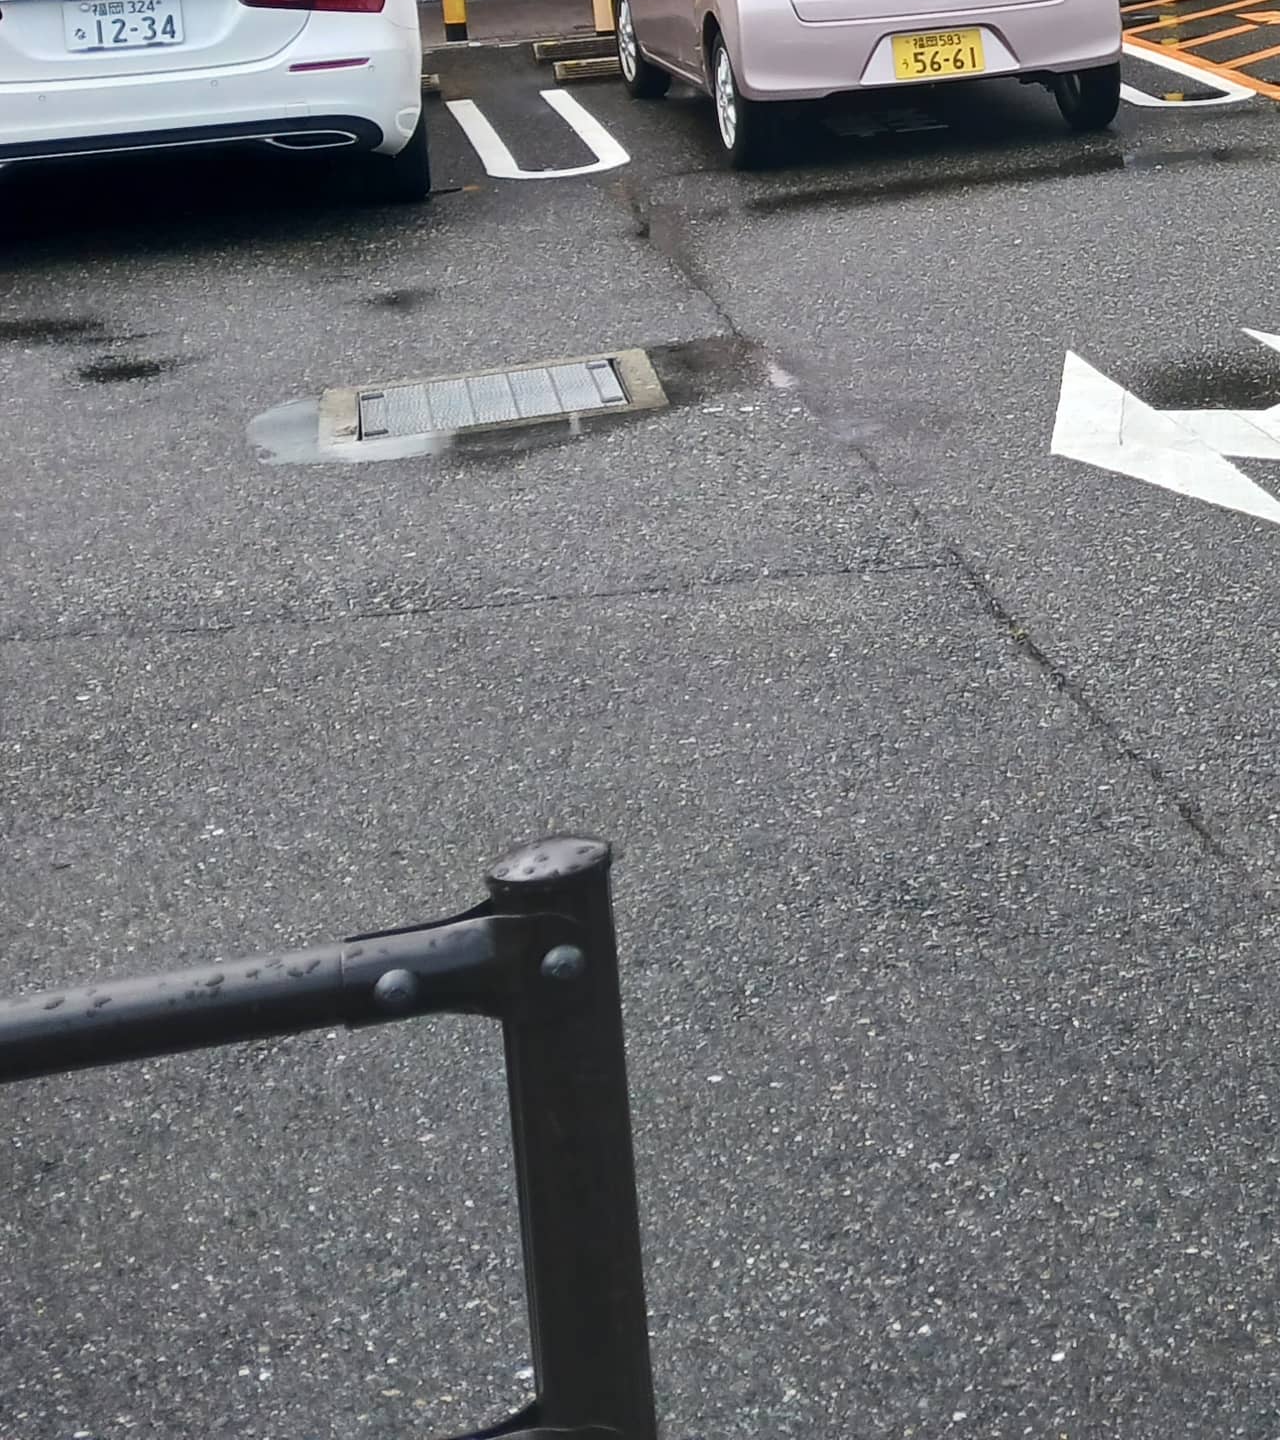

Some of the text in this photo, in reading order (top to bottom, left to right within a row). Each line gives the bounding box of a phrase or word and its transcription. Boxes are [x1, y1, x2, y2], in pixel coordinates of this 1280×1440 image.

[93, 0, 156, 16] 福岡 324
[96, 14, 175, 44] 12-34
[913, 35, 937, 48] 福岡
[913, 47, 976, 73] 56-61
